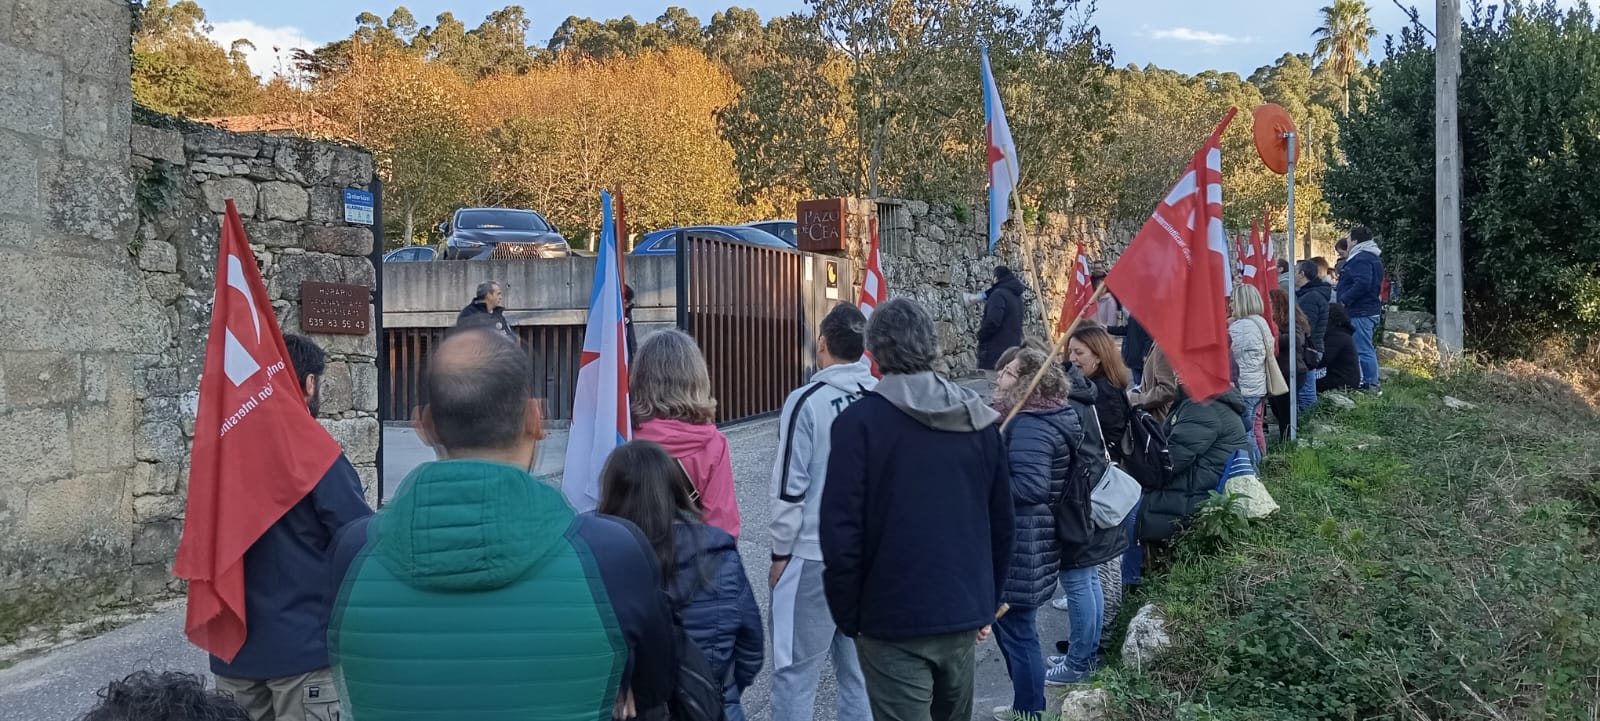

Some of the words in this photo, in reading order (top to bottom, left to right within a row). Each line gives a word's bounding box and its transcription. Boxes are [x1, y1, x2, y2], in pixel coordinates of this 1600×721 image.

[804, 210, 840, 225] PAZO
[809, 223, 839, 241] CEA
[320, 288, 353, 297] HORARIO
[355, 320, 365, 330] 43
